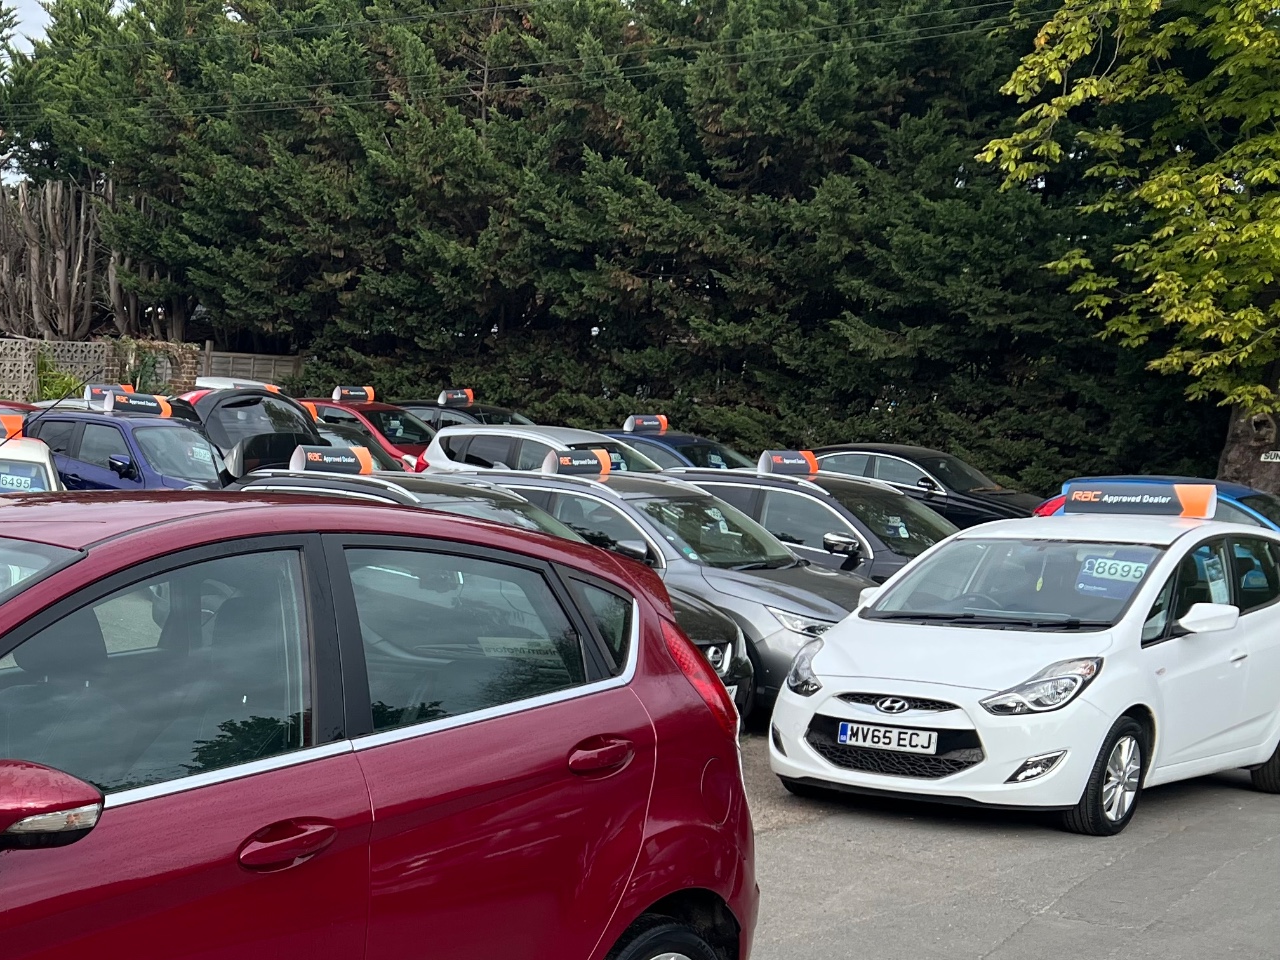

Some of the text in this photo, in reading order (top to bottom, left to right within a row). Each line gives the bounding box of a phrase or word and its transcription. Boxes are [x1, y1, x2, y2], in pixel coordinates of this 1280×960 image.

[1102, 494, 1141, 503] Approved
[1142, 495, 1171, 503] Dealer
[1083, 559, 1145, 579] £8695
[849, 725, 932, 749] MV65 ECJ
